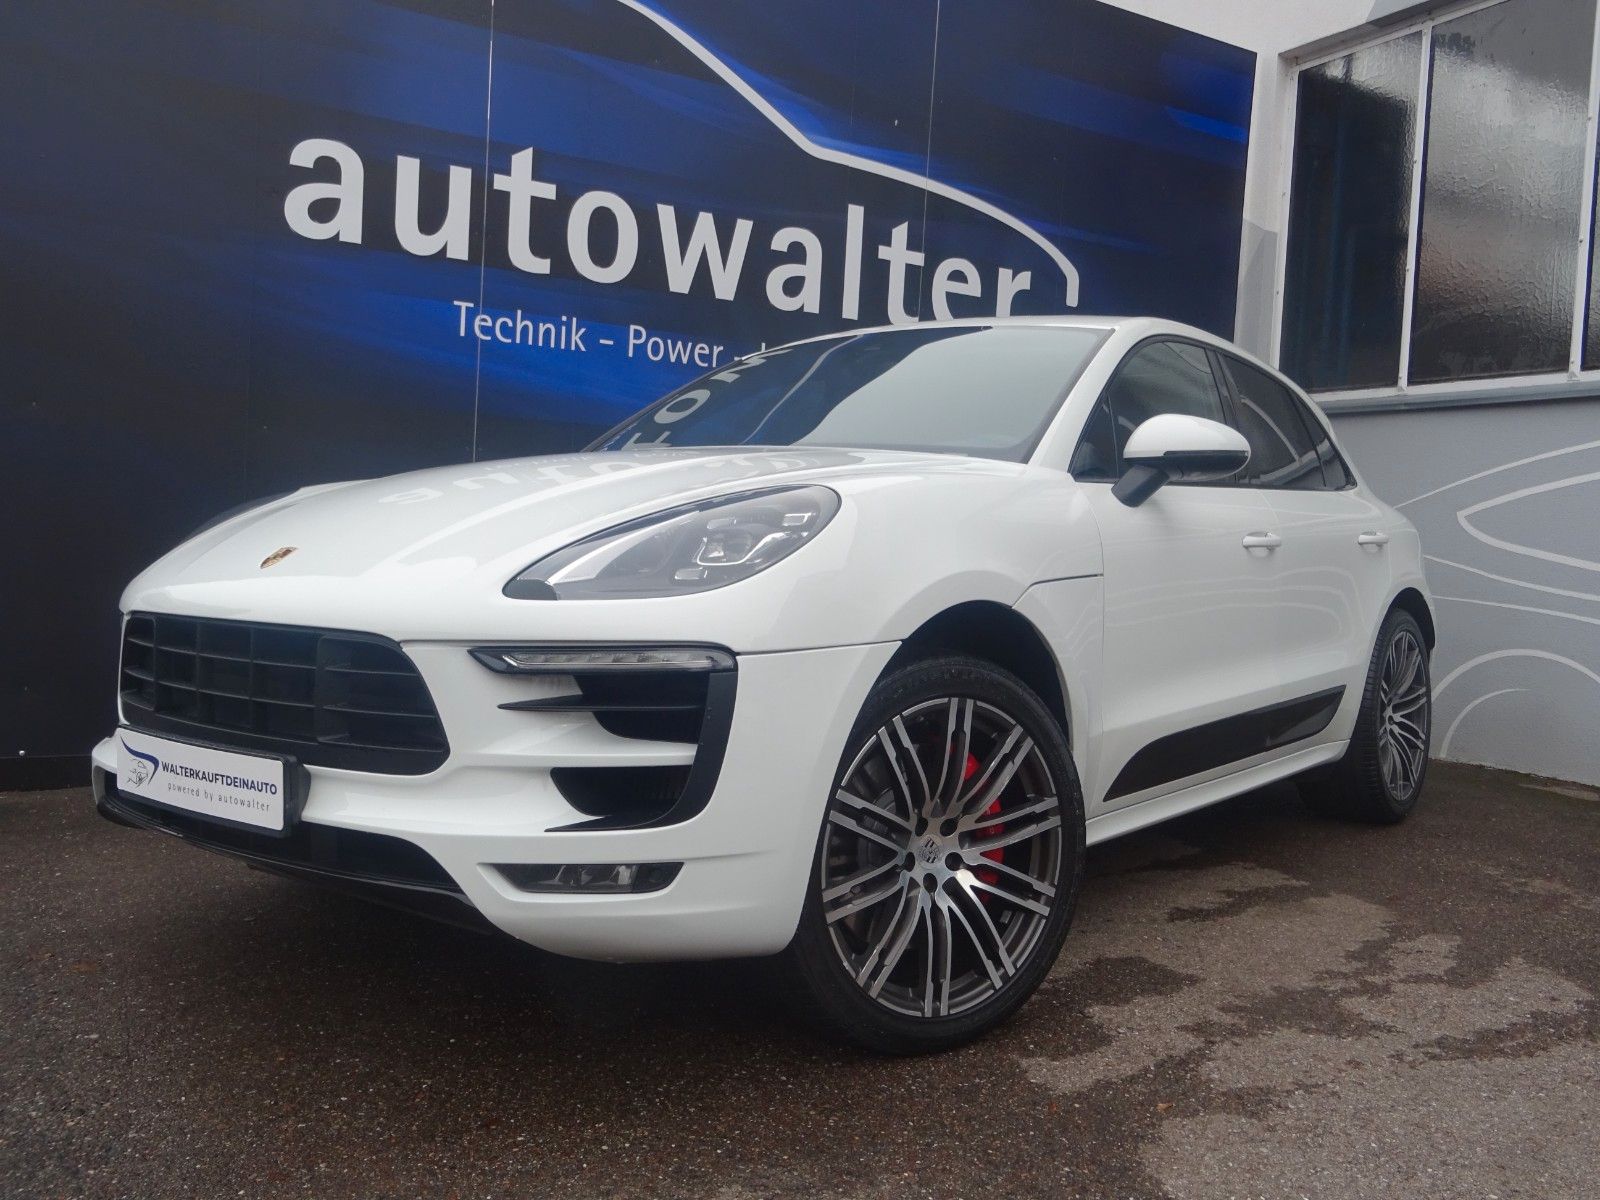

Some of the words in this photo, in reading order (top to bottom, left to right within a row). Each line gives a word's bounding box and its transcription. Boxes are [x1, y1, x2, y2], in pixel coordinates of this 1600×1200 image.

[284, 138, 1032, 325] autowalter
[453, 300, 587, 352] Technik
[627, 324, 724, 368] Power
[161, 761, 278, 795] WALTERKAUFTDEINAUTO
[167, 782, 200, 797] powered
[204, 789, 214, 803] by
[218, 794, 271, 812] autowalter
